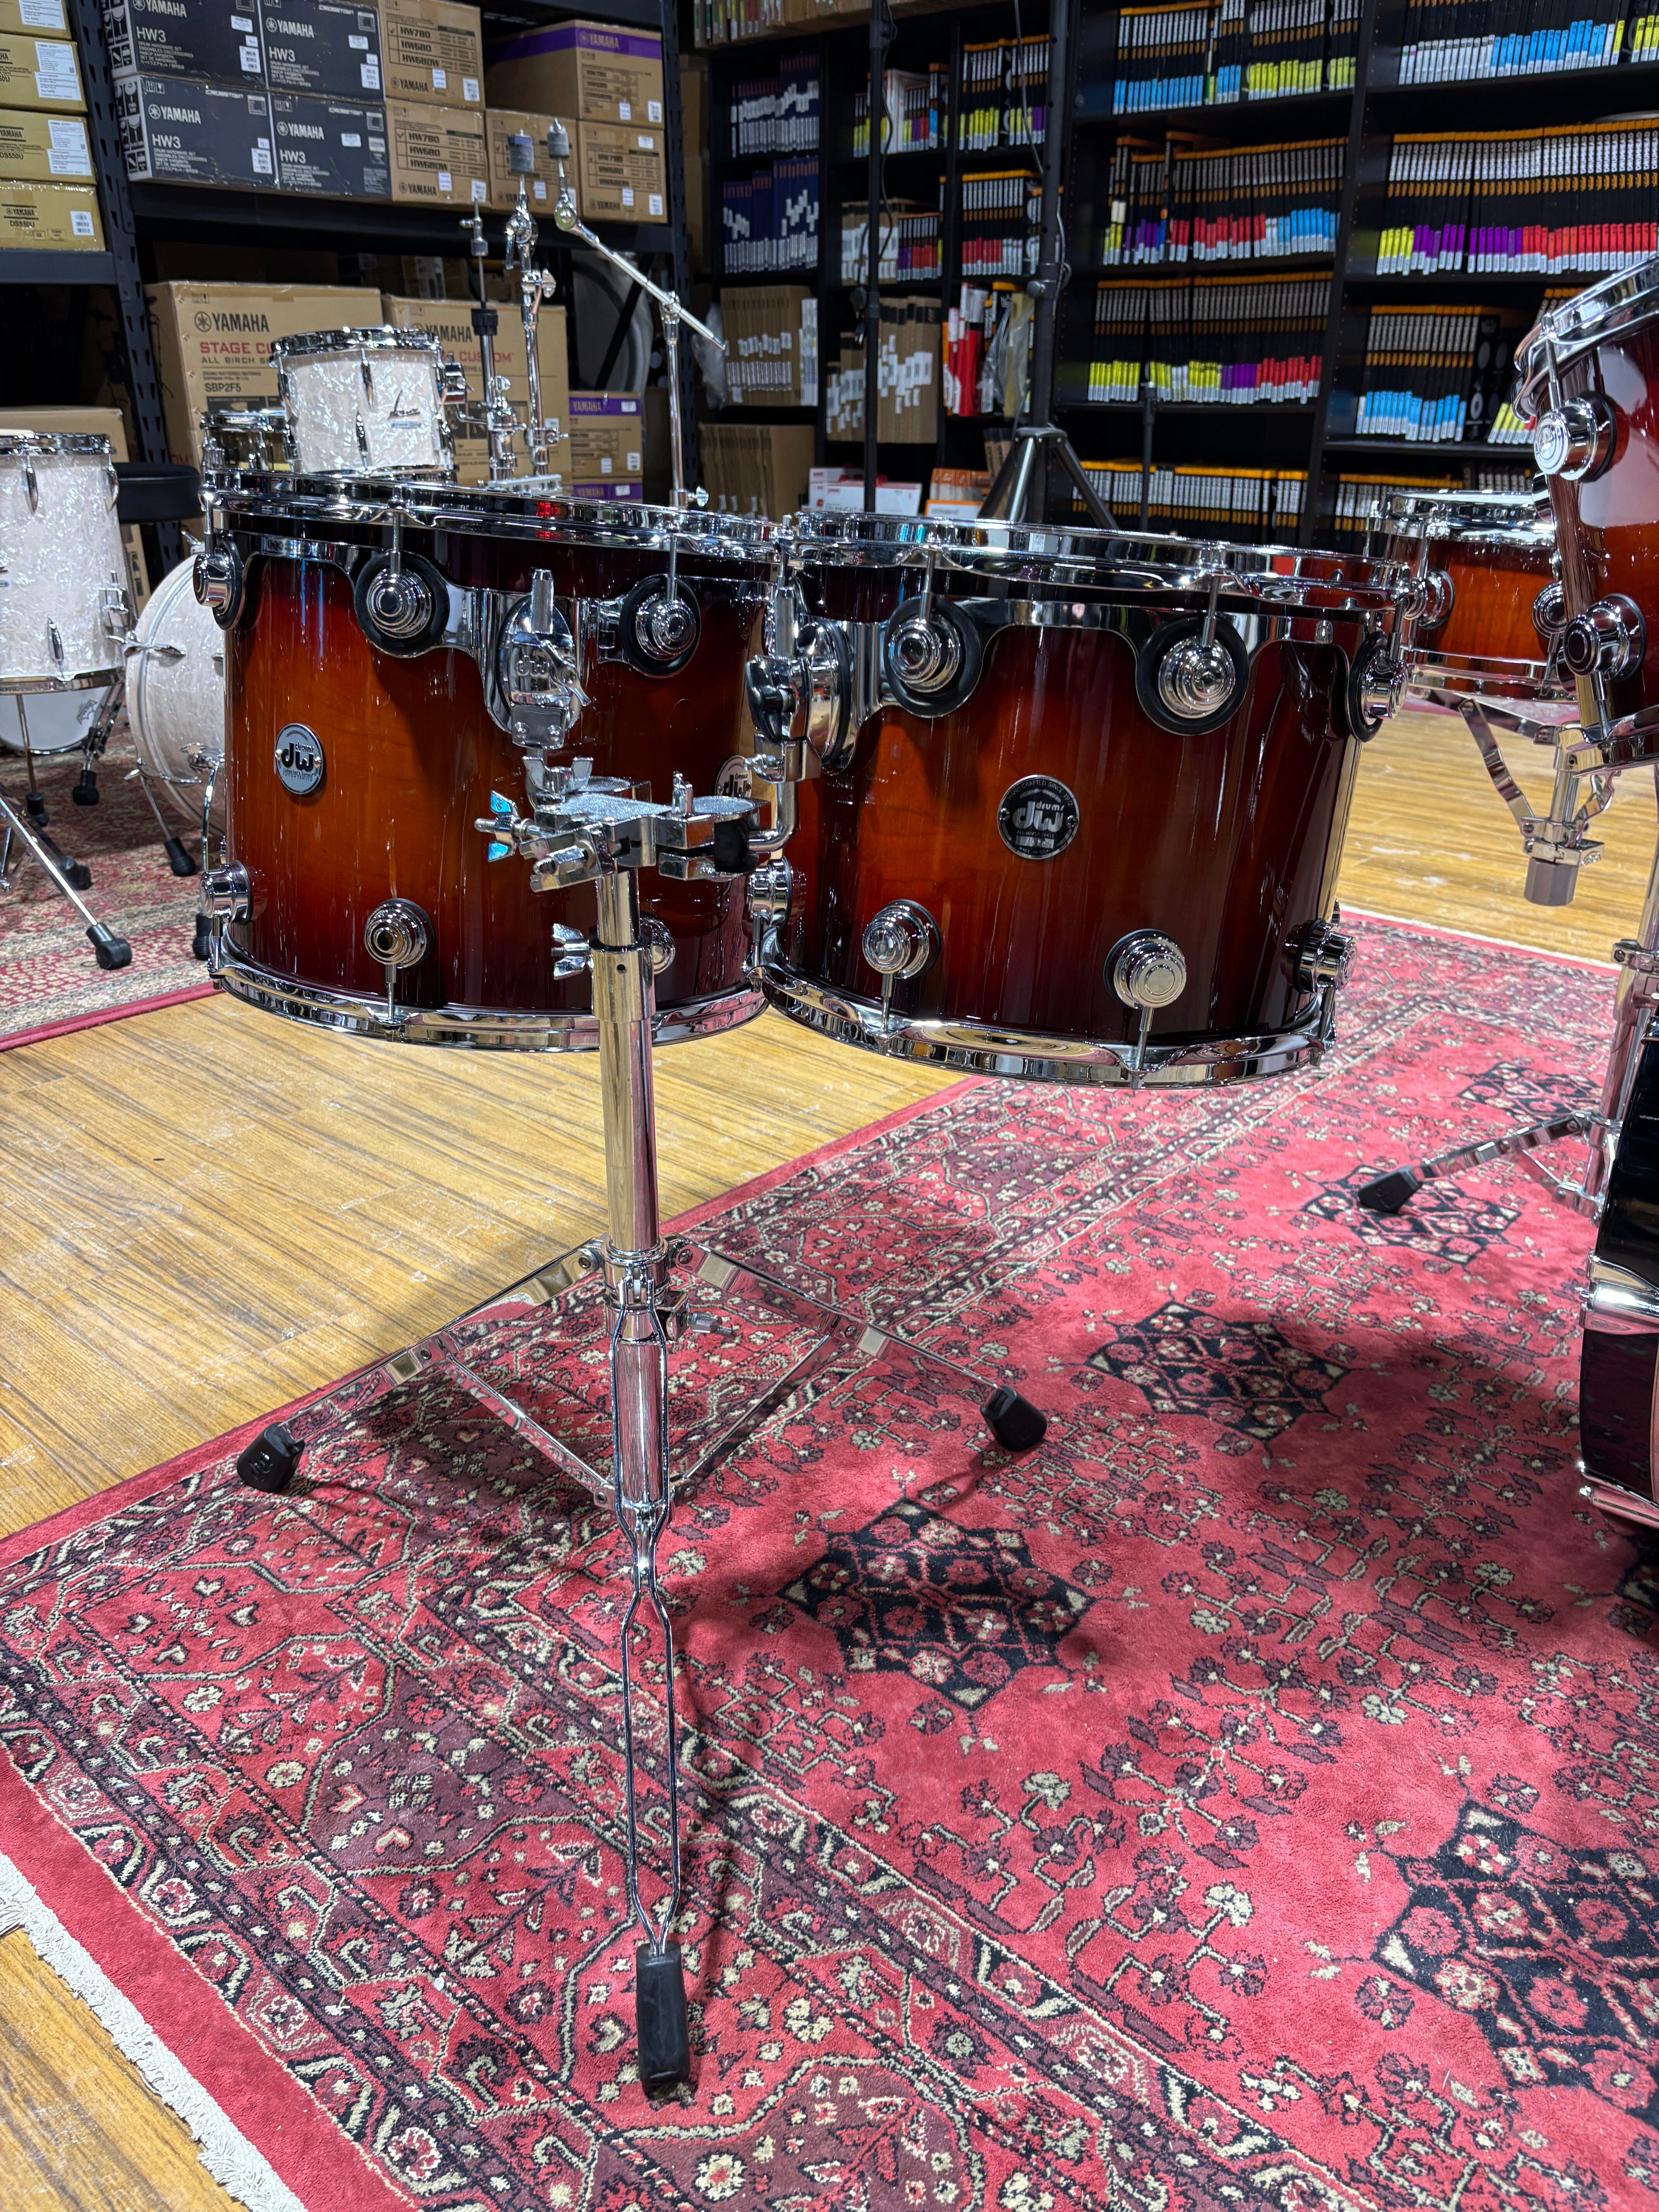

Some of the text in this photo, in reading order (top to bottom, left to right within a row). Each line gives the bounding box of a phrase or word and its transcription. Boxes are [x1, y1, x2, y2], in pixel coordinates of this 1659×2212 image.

[146, 0, 187, 18] YAMAHA
[136, 26, 167, 43] HW3
[277, 19, 314, 38] YAMAHA
[400, 27, 431, 39] HW780
[401, 40, 431, 52] HW680
[589, 33, 620, 49] YAMAHA
[269, 46, 295, 62] HW3
[402, 54, 440, 67] HW680W
[400, 79, 429, 93] YAMAHA
[161, 106, 201, 124] YAMAHA
[288, 122, 325, 140] YAMAHA
[409, 132, 440, 143] HW780
[152, 134, 181, 149] HW3
[280, 149, 306, 163] HW3
[410, 146, 440, 157] HW680
[408, 184, 437, 196] YAMAHA
[212, 313, 270, 332] YAMAHA
[426, 325, 472, 343] YAMAHA
[200, 342, 251, 354] STAGE
[204, 383, 242, 392] SBP2F5
[282, 742, 314, 772] dw
[1008, 786, 1021, 800] HAND
[1022, 779, 1046, 789] CRAFTED
[1048, 781, 1063, 794] SINCE
[1063, 793, 1073, 807] 1972
[1036, 801, 1065, 811] drums
[1012, 801, 1064, 833] dw
